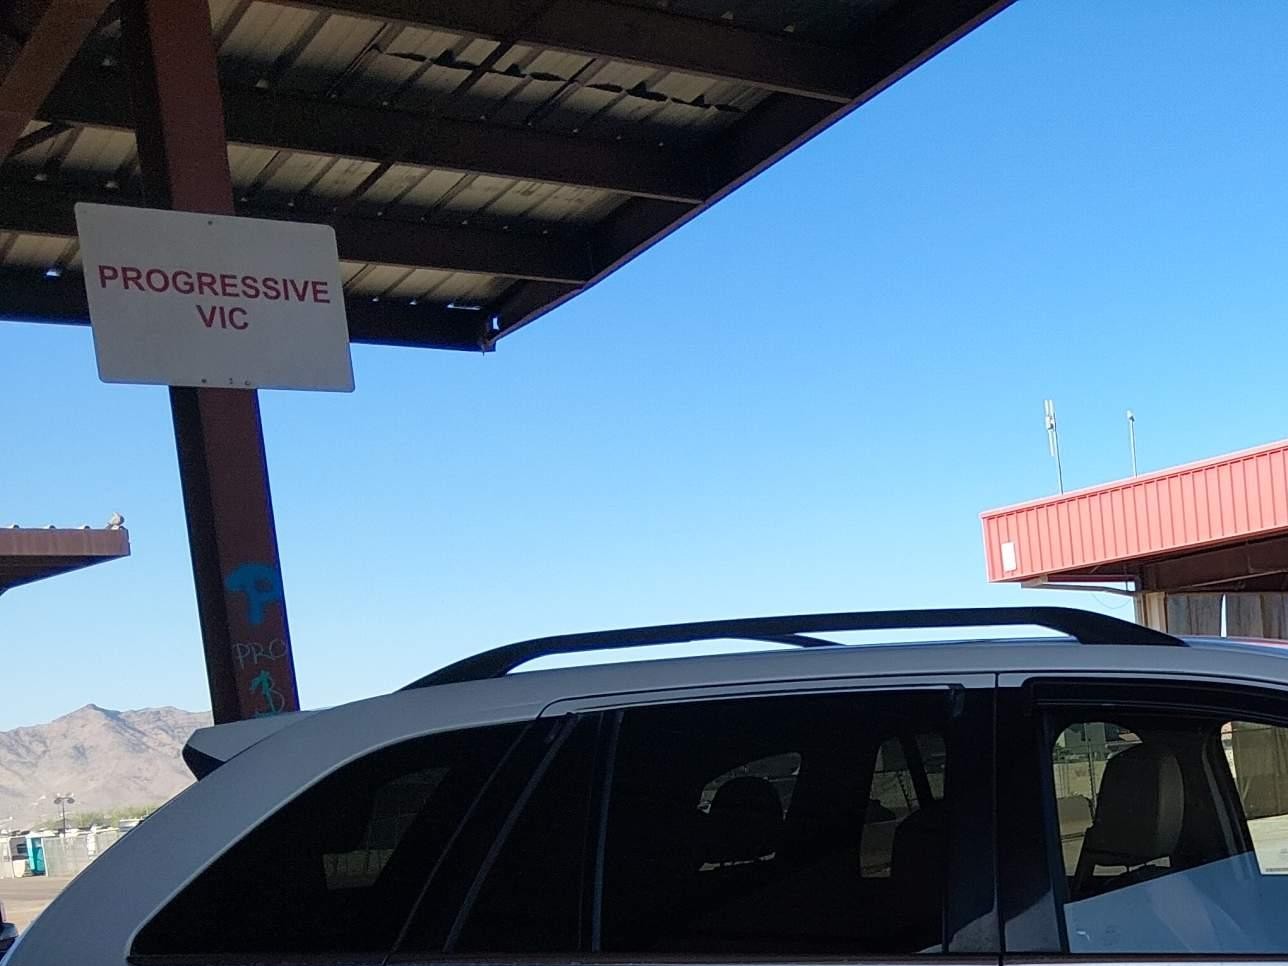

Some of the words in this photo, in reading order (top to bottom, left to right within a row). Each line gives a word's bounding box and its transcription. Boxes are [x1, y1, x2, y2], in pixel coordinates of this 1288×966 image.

[98, 264, 331, 304] PROGRESSIVE
[195, 304, 250, 331] VIC
[232, 639, 288, 670] PRO
